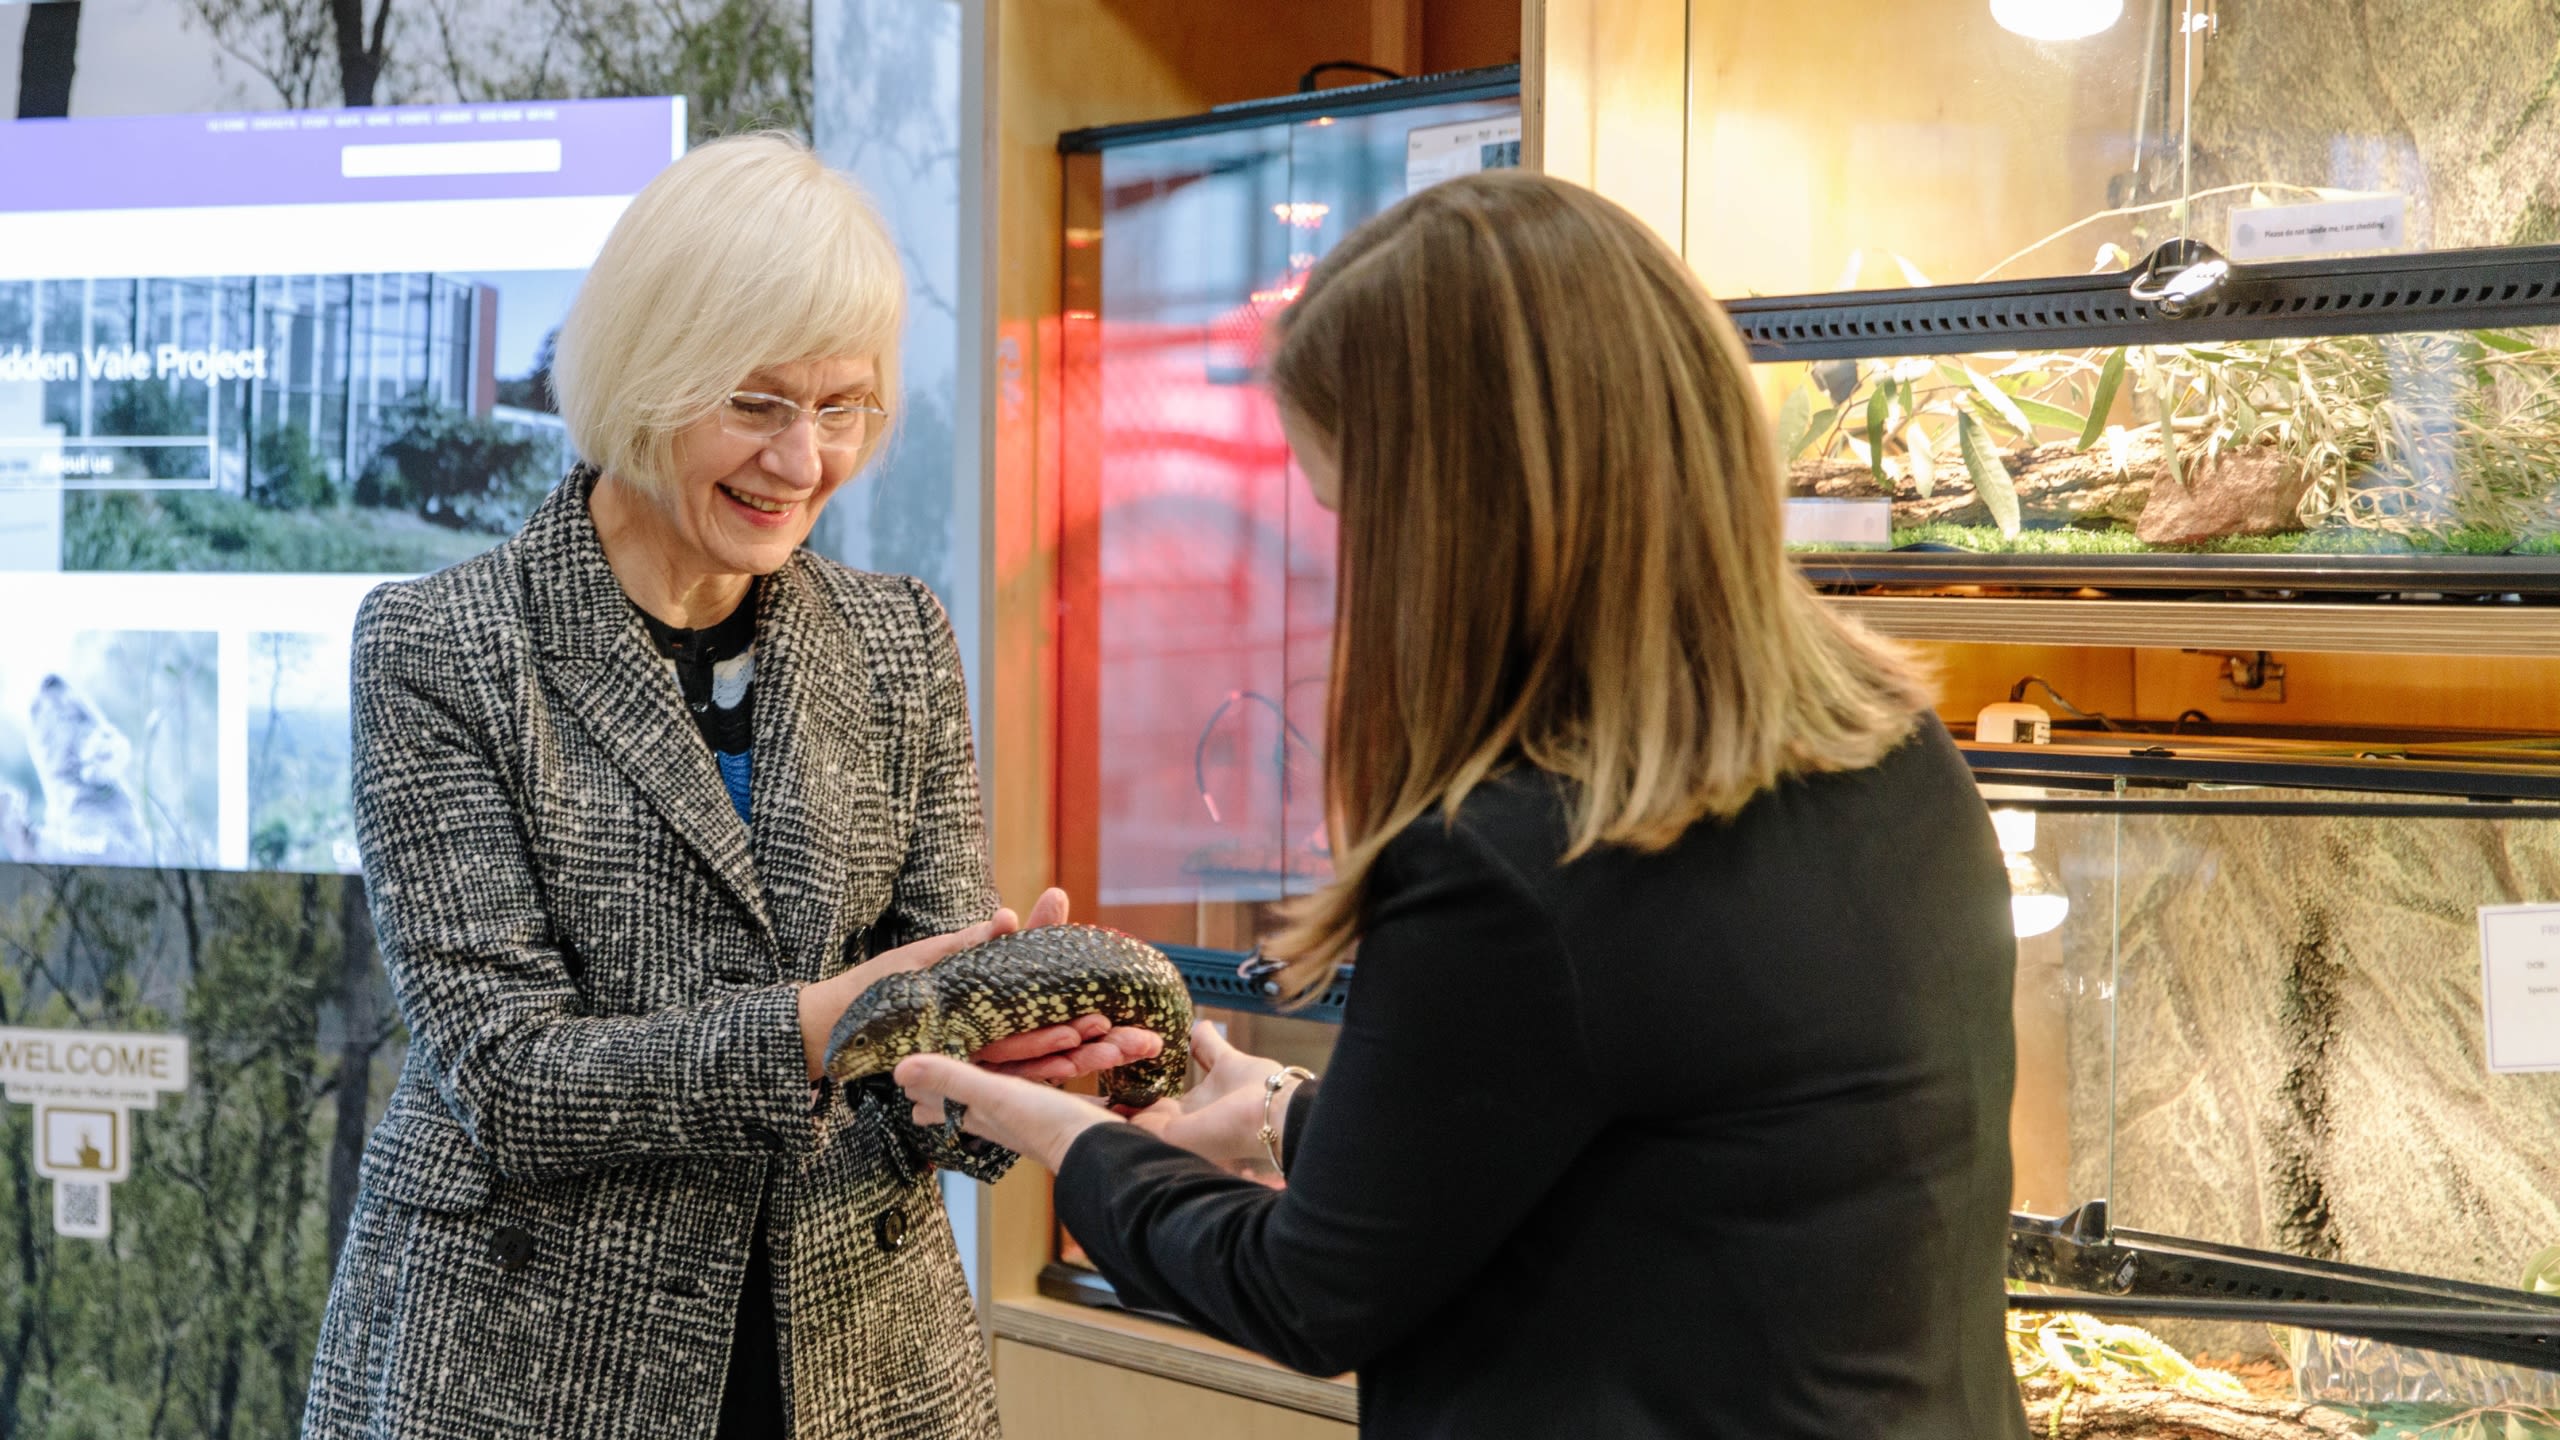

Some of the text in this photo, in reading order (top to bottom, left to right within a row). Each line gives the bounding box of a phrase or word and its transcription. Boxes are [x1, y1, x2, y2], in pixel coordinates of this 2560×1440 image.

[82, 343, 151, 381] Vale
[157, 343, 268, 387] Project
[0, 1039, 170, 1079] WELCOME
